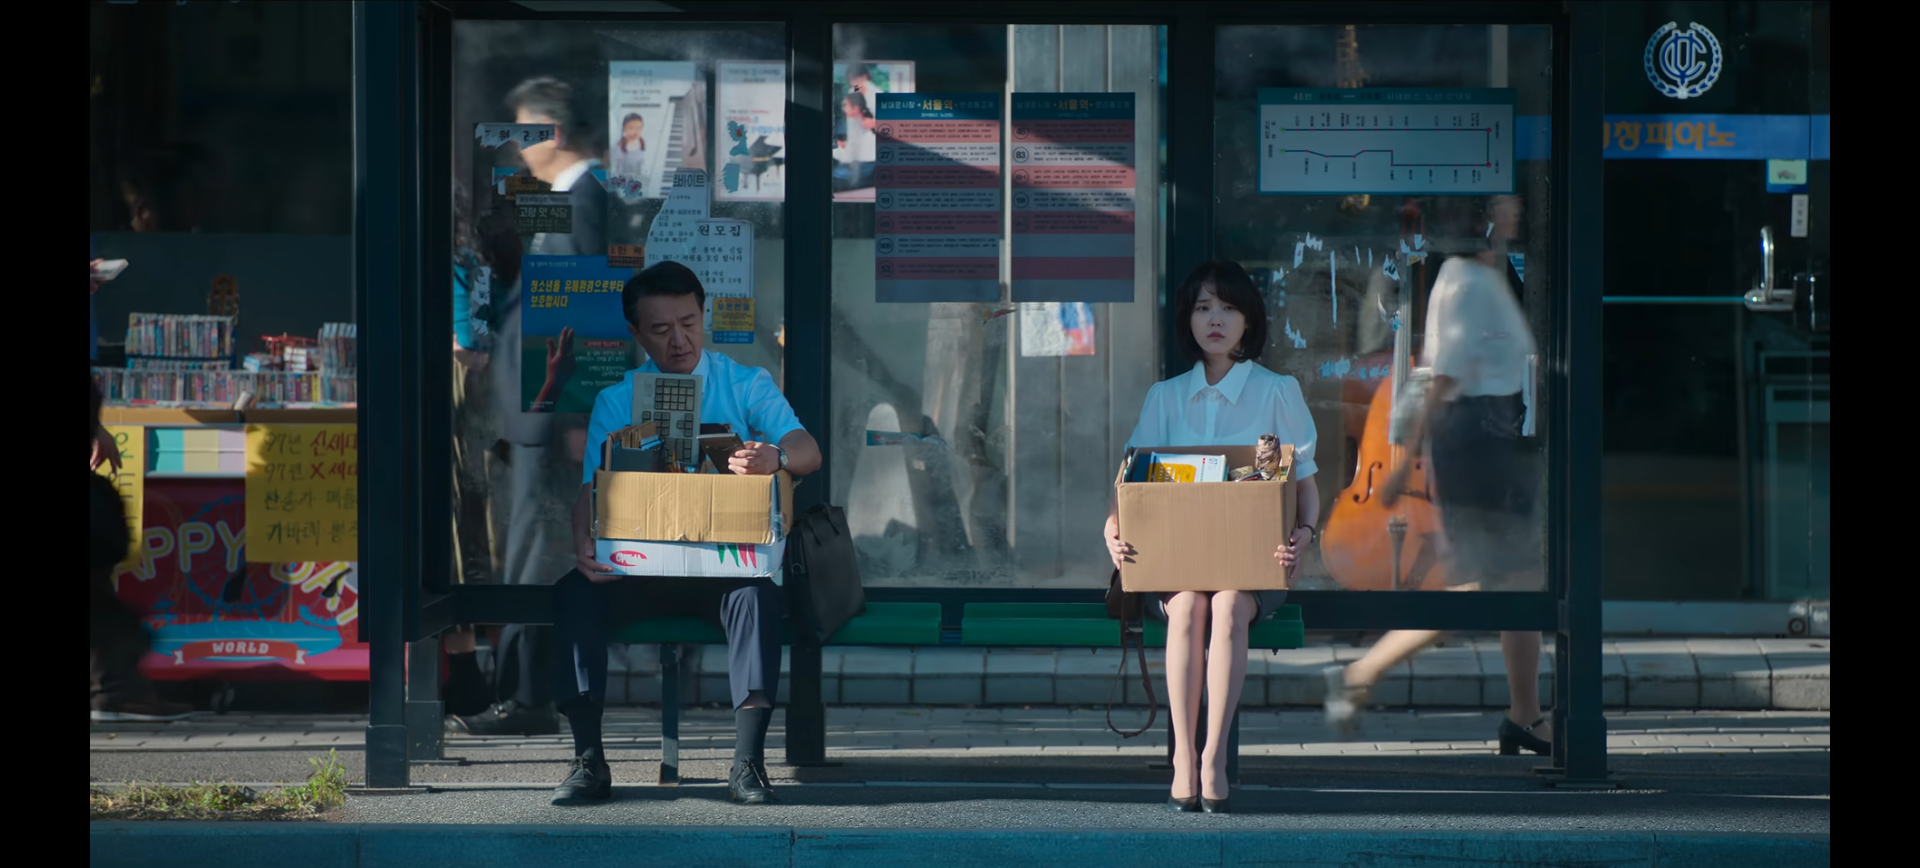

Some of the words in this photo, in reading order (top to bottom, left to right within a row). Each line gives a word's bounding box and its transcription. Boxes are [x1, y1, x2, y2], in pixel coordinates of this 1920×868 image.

[923, 99, 954, 110] 서울역
[1058, 99, 1089, 110] 서울역
[880, 127, 890, 136] 42
[1603, 120, 1736, 151] 창피아노
[880, 151, 890, 159] 27
[1015, 150, 1026, 159] 83
[530, 280, 561, 293] 청소년을
[530, 295, 569, 308] 보호합시다
[264, 432, 301, 454] 97년
[212, 642, 269, 654] WORLD
